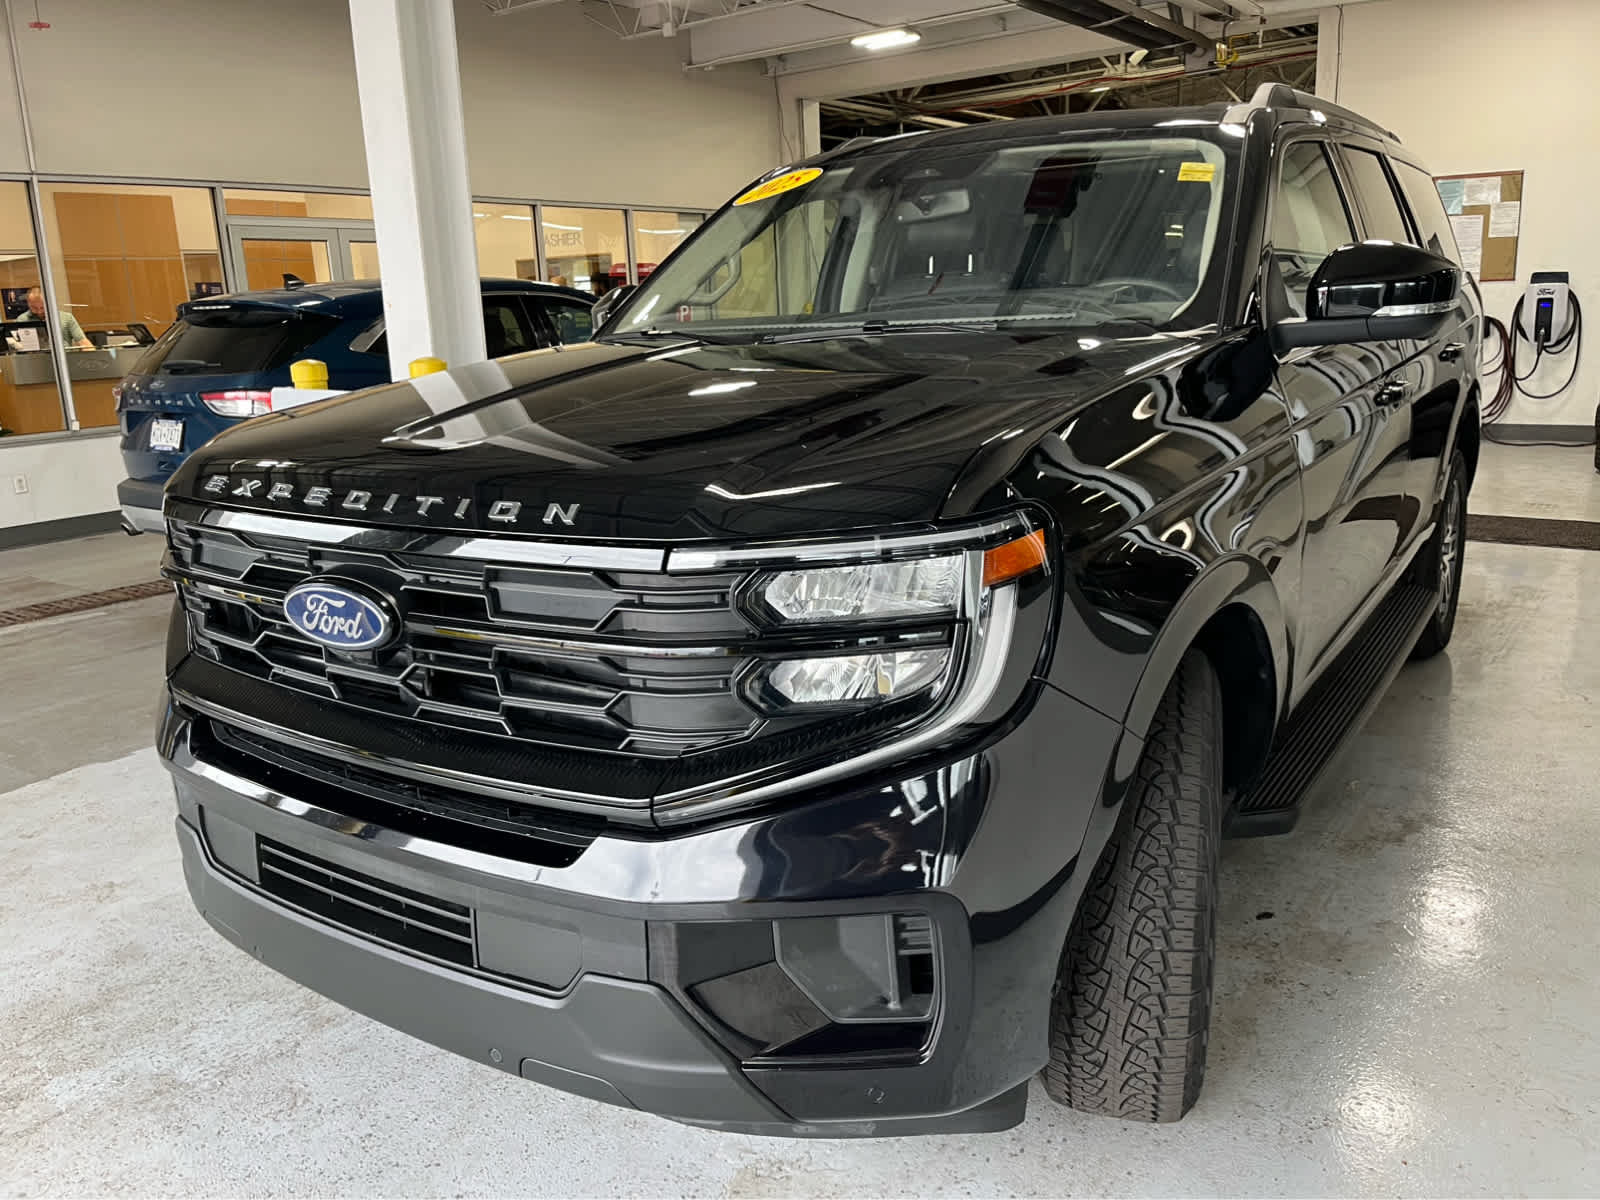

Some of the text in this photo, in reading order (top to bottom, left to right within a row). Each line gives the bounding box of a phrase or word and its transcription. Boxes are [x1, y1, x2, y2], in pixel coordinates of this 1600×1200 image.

[543, 231, 584, 248] ASHIER
[204, 475, 581, 526] EXPEDITION
[303, 594, 362, 640] Ford
